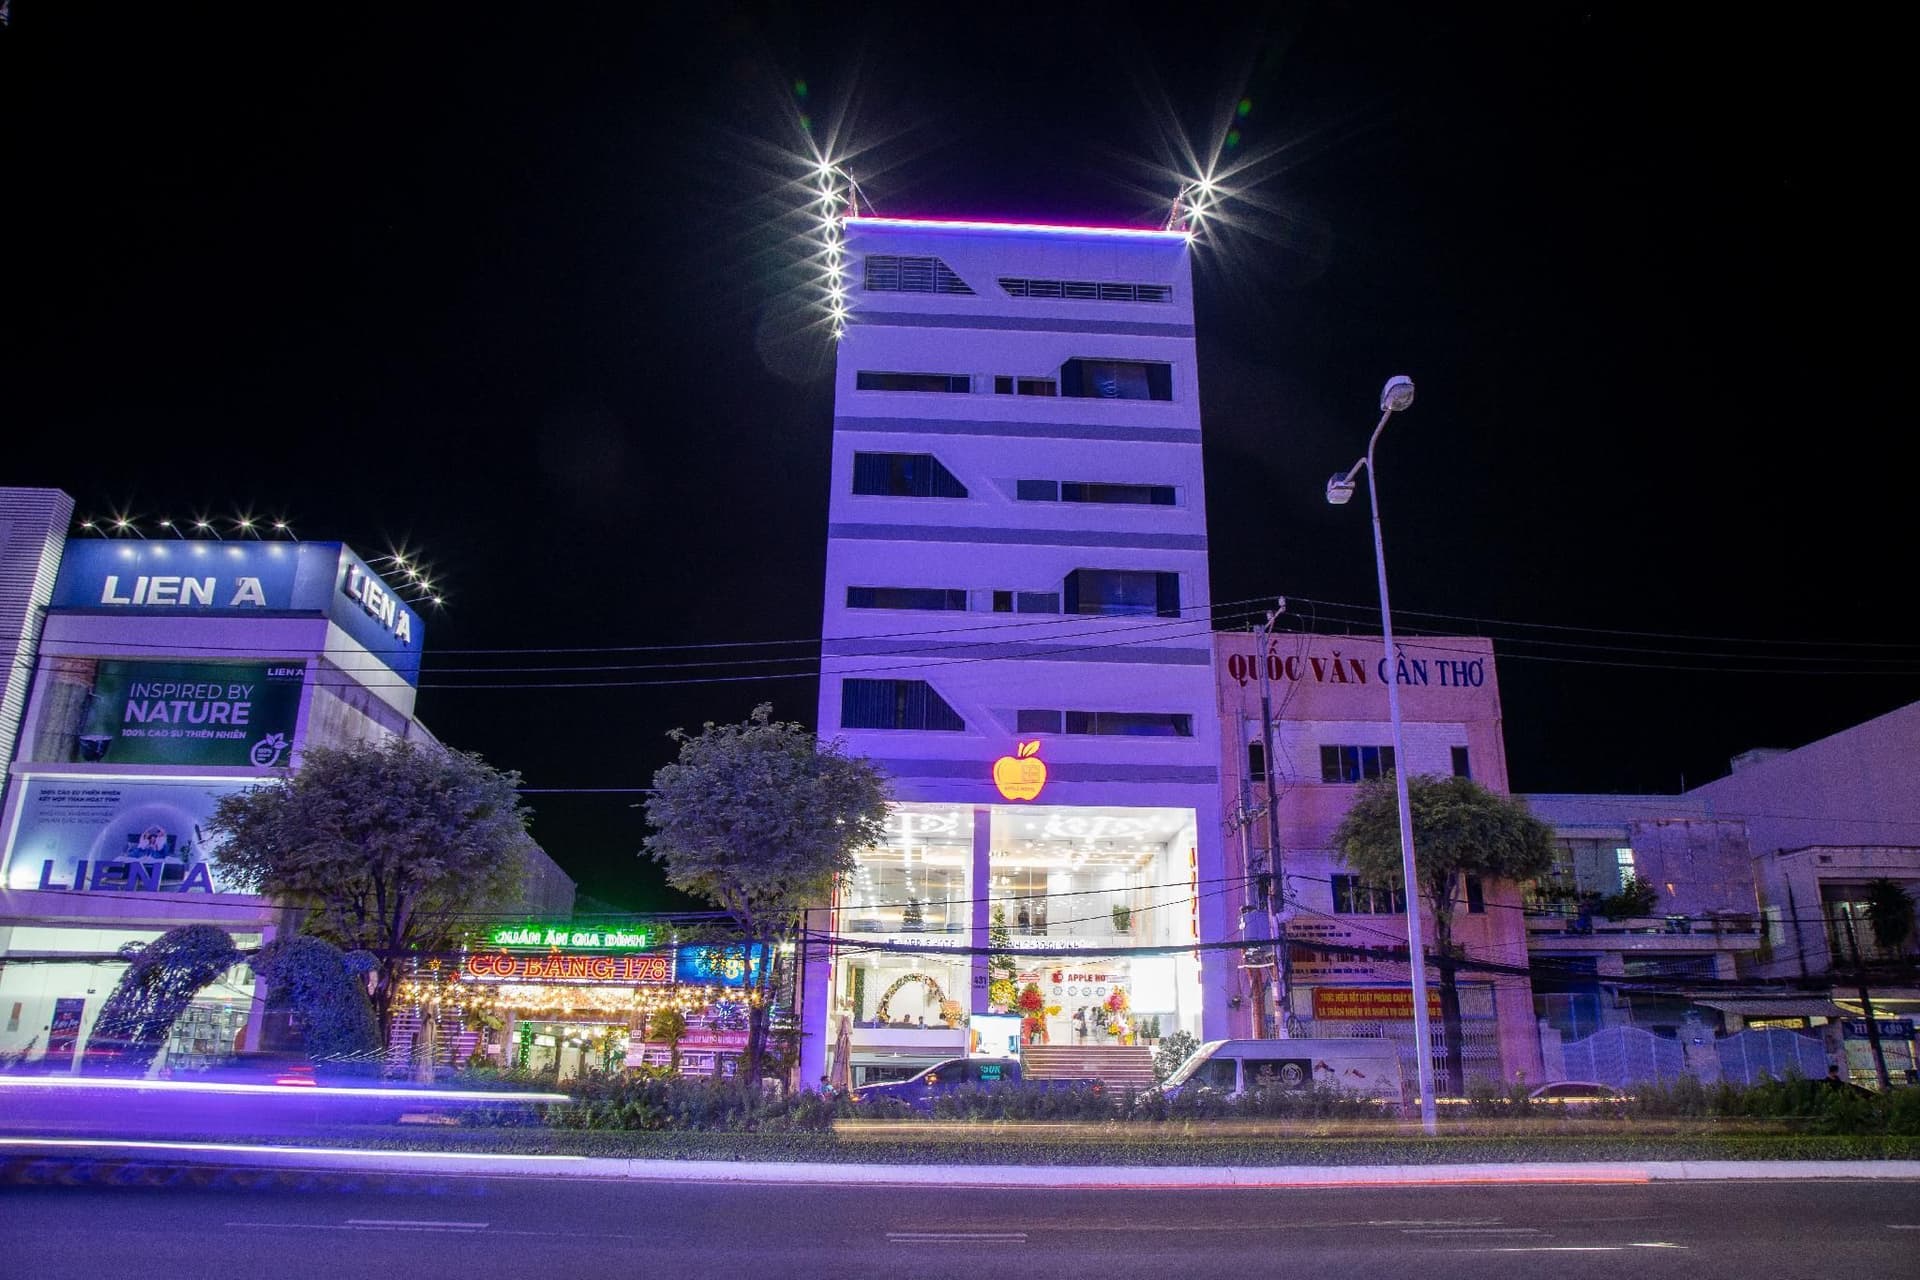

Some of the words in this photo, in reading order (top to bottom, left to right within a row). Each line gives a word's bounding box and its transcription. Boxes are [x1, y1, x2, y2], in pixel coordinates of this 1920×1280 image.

[101, 576, 216, 605] LIEN
[348, 564, 396, 628] LIEN
[1308, 651, 1367, 684] VĂN
[1435, 657, 1485, 687] THƠ
[130, 683, 222, 699] INSPIRED
[227, 684, 254, 699] BY
[124, 700, 251, 725] NATURE
[122, 728, 145, 737] 100%
[148, 729, 168, 737] CAO
[39, 859, 165, 892] LIEN
[572, 933, 599, 946] GIA
[623, 957, 667, 980] 178
[1067, 973, 1093, 982] APPLE
